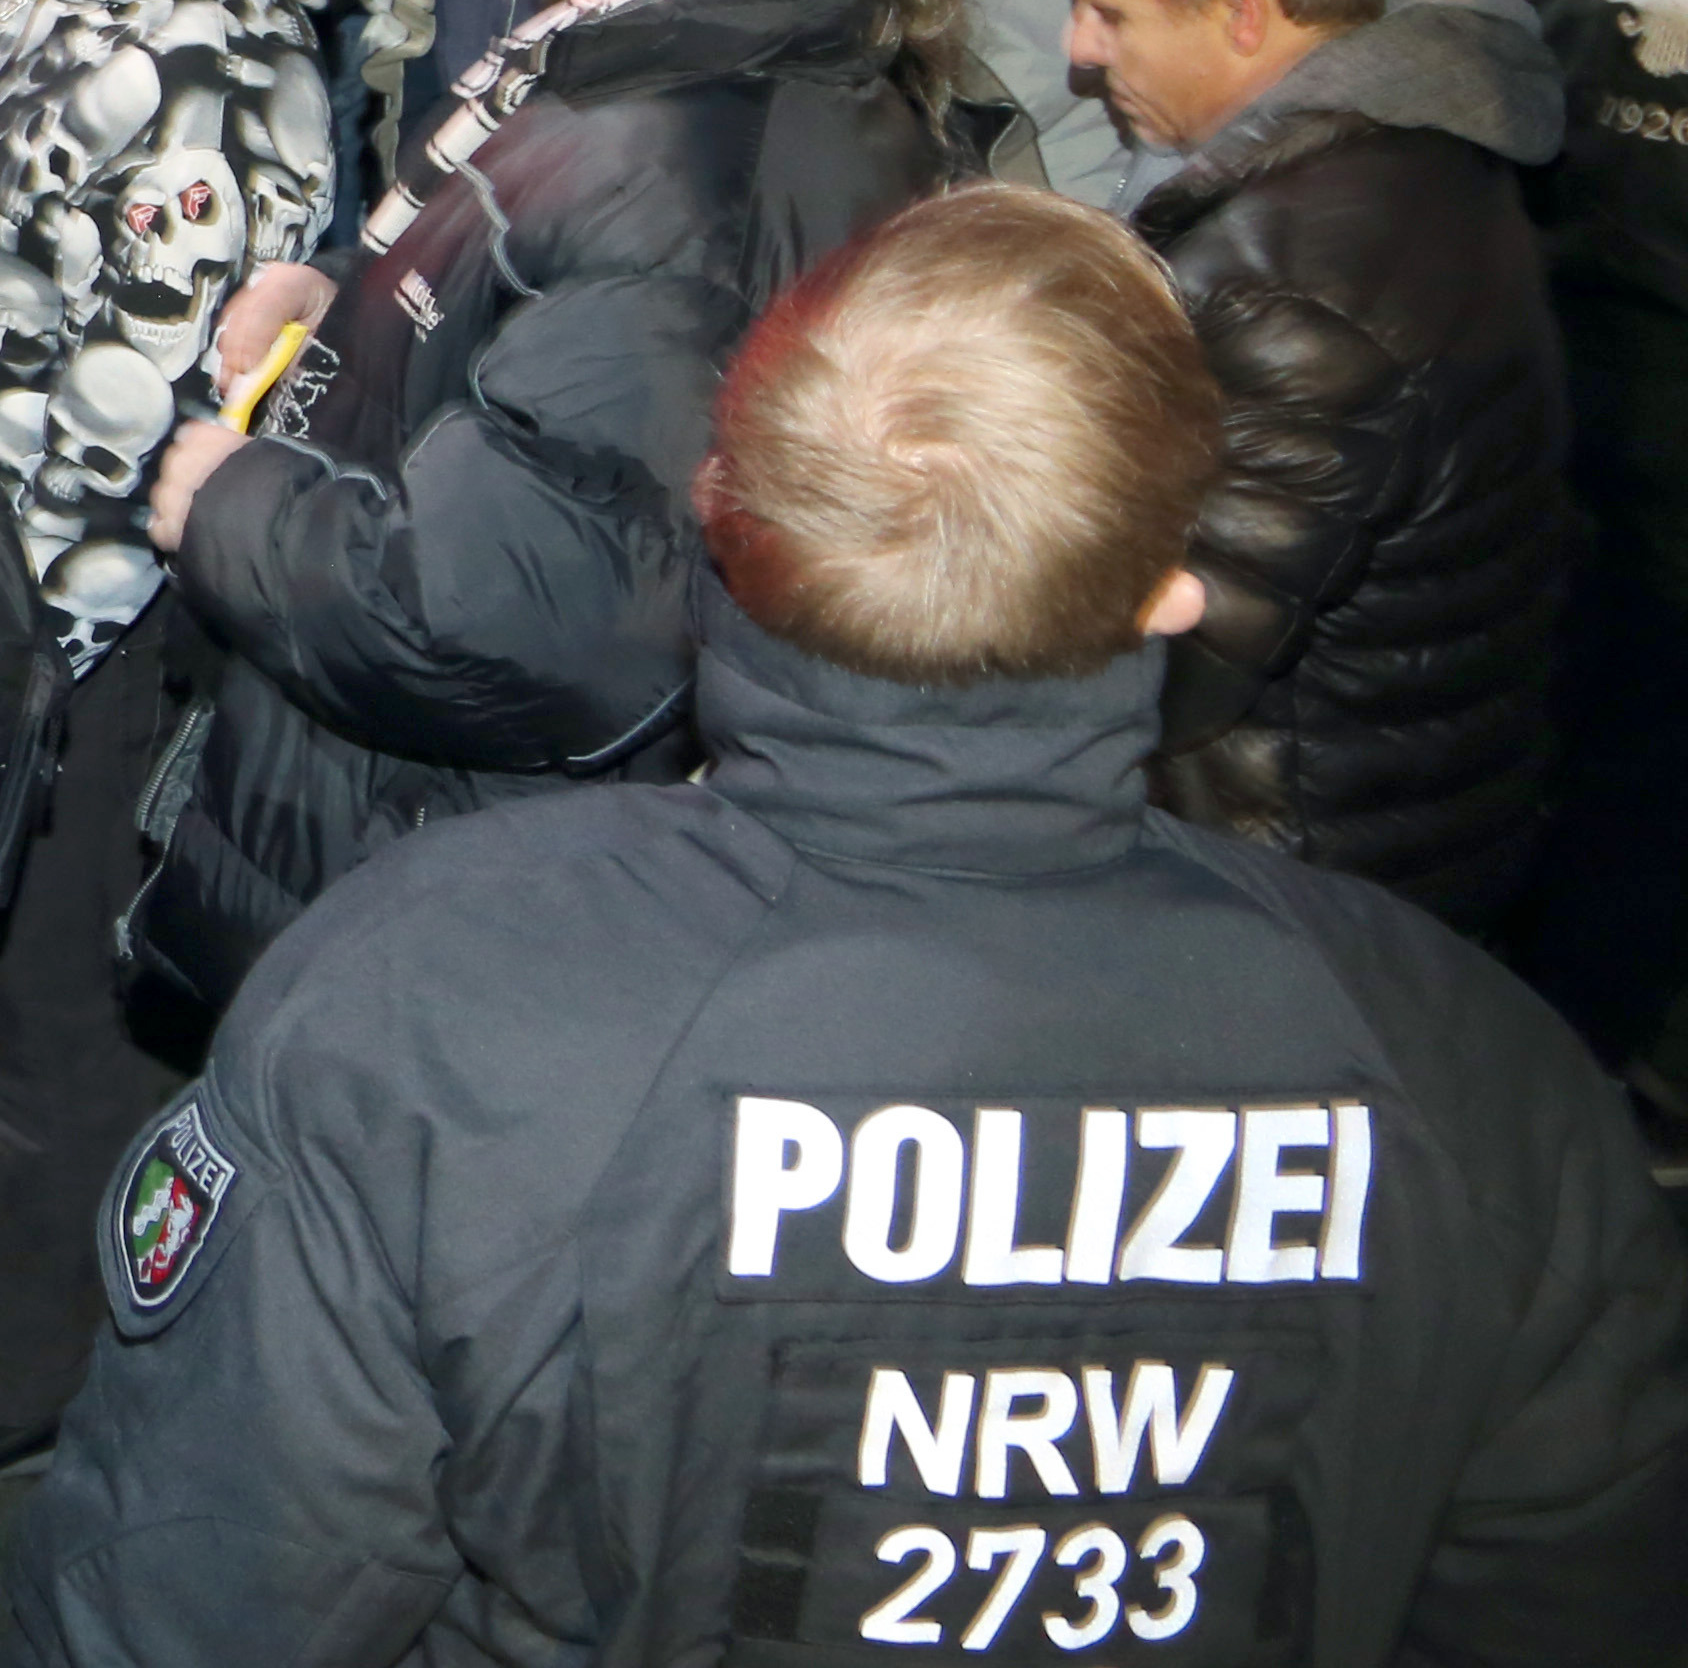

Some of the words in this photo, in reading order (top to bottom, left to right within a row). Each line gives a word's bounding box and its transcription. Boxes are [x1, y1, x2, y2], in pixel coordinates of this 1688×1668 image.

[171, 1112, 226, 1200] POLIZEI
[728, 1095, 1372, 1286] POLIZEI
[857, 1359, 1235, 1499] NRW
[859, 1512, 1207, 1652] 2733
